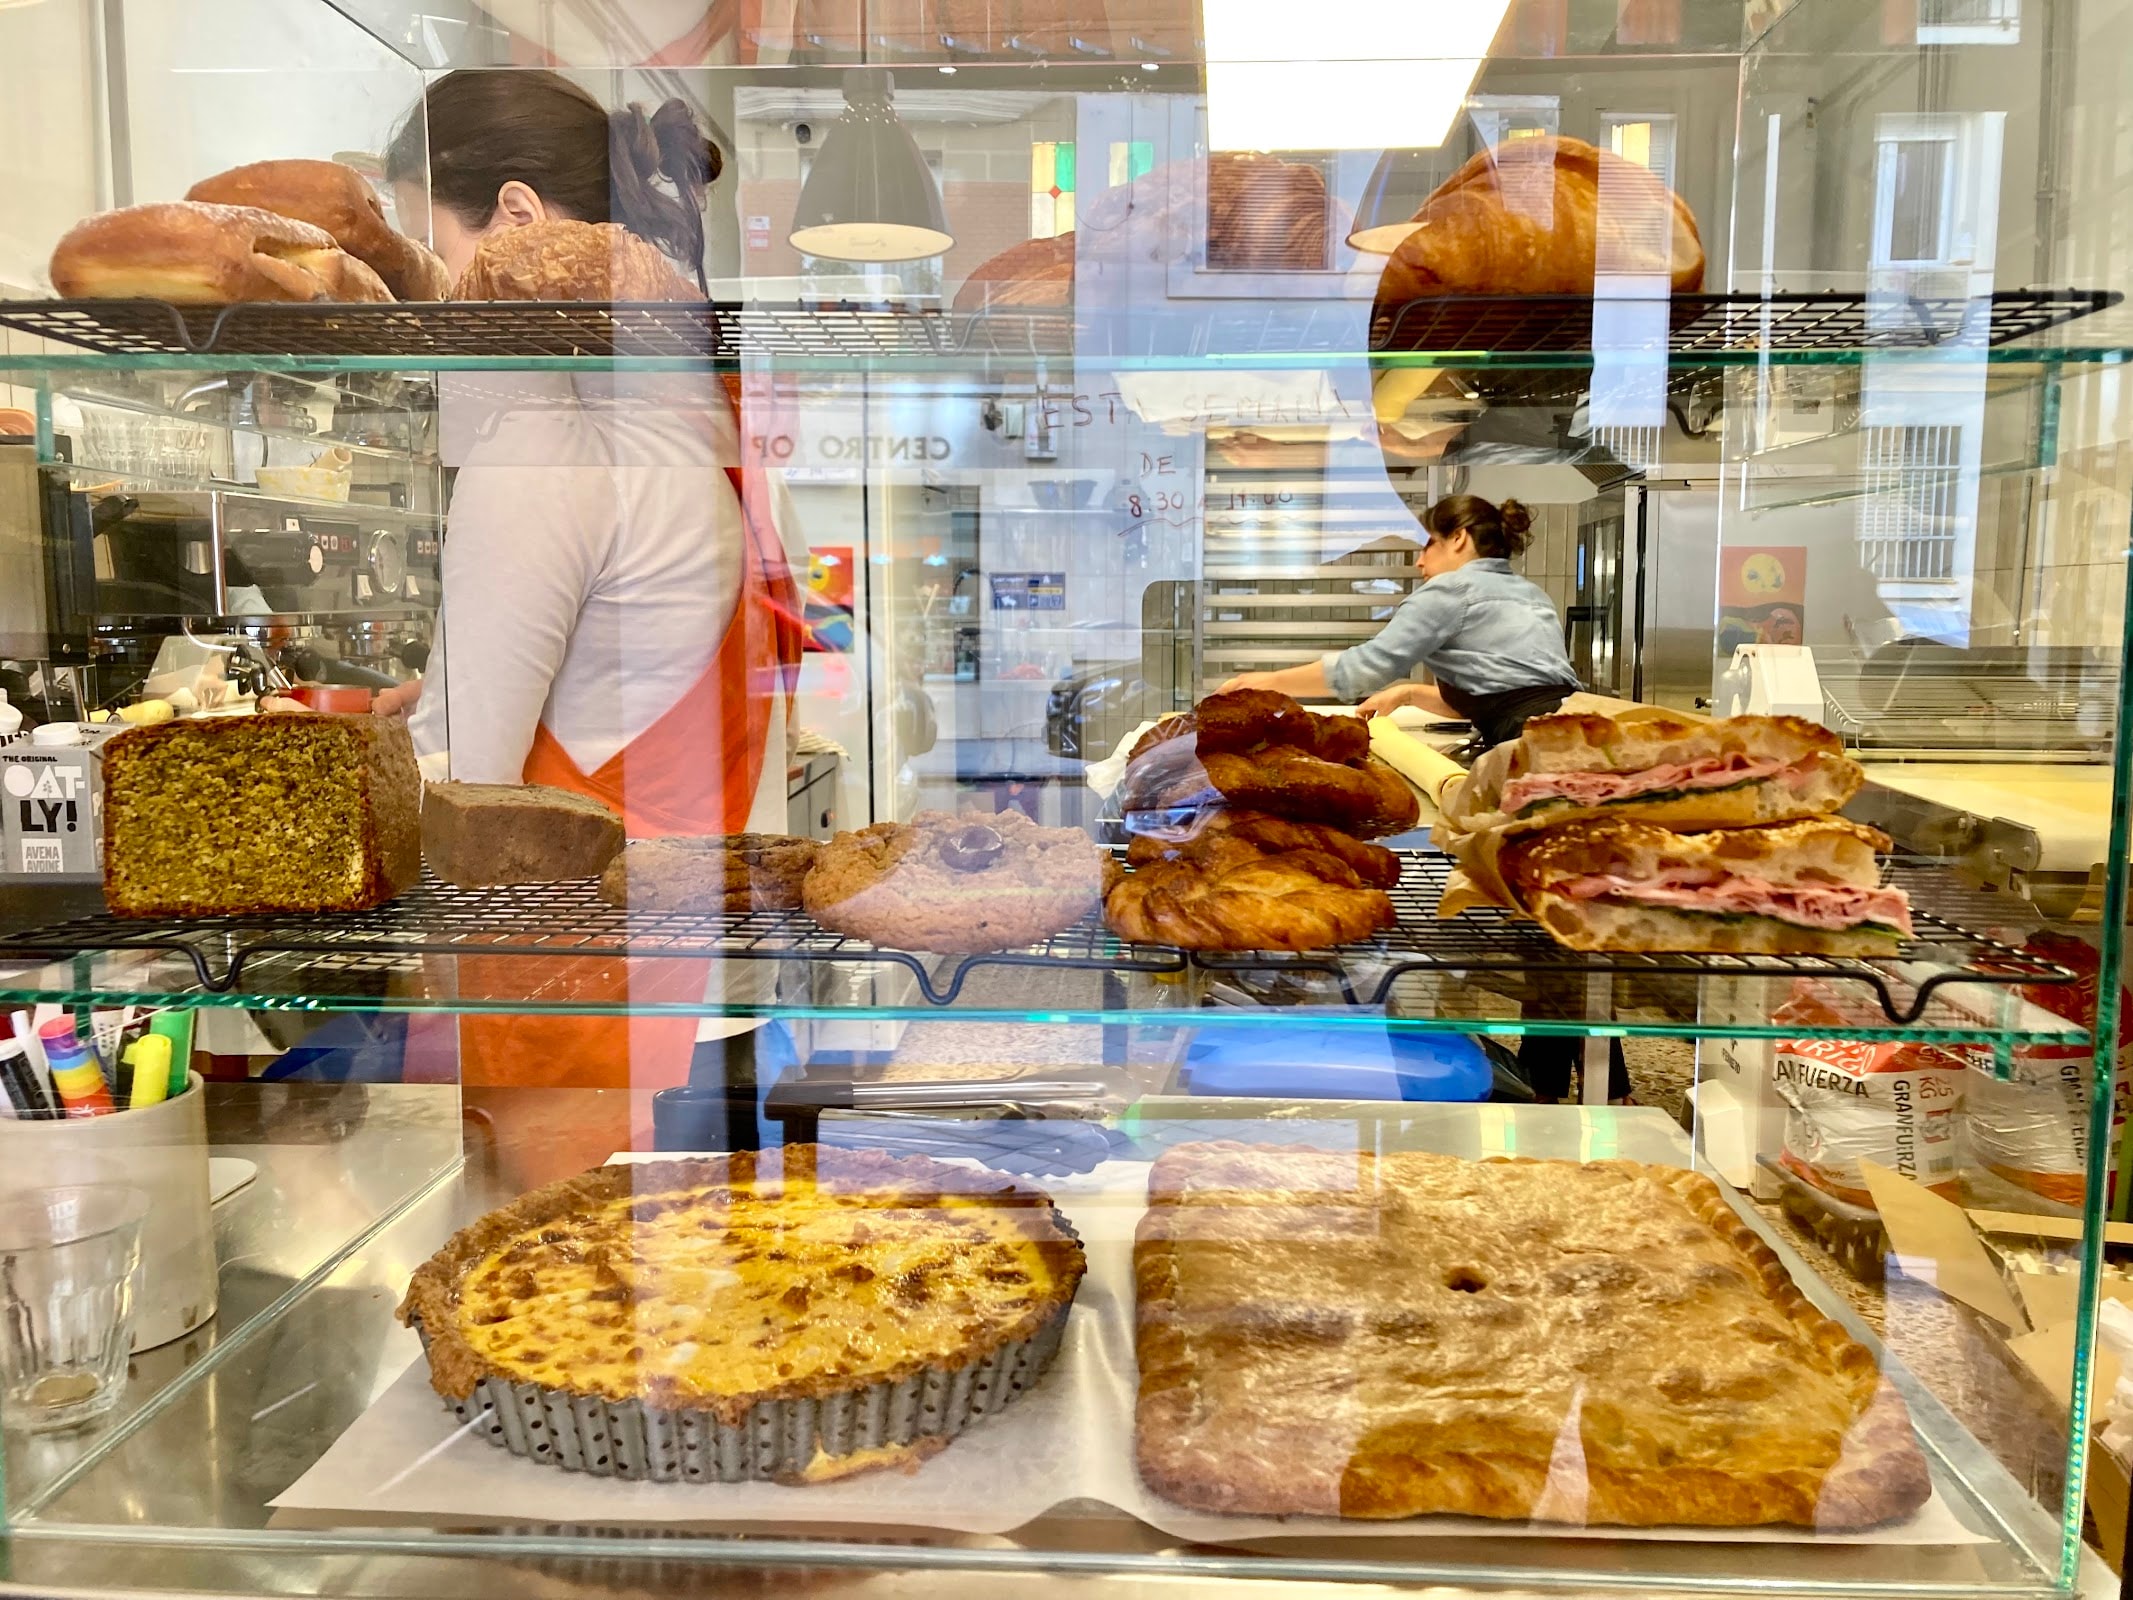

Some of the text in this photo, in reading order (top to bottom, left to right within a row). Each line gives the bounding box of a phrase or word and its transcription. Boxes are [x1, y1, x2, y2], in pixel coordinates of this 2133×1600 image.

[1139, 450, 1177, 478] DE
[1128, 491, 1185, 518] 8:30
[2, 755, 58, 763] THE ORIGINAL
[20, 800, 77, 833] LY!
[25, 846, 60, 860] AVENA
[1918, 1076, 1938, 1100] KG
